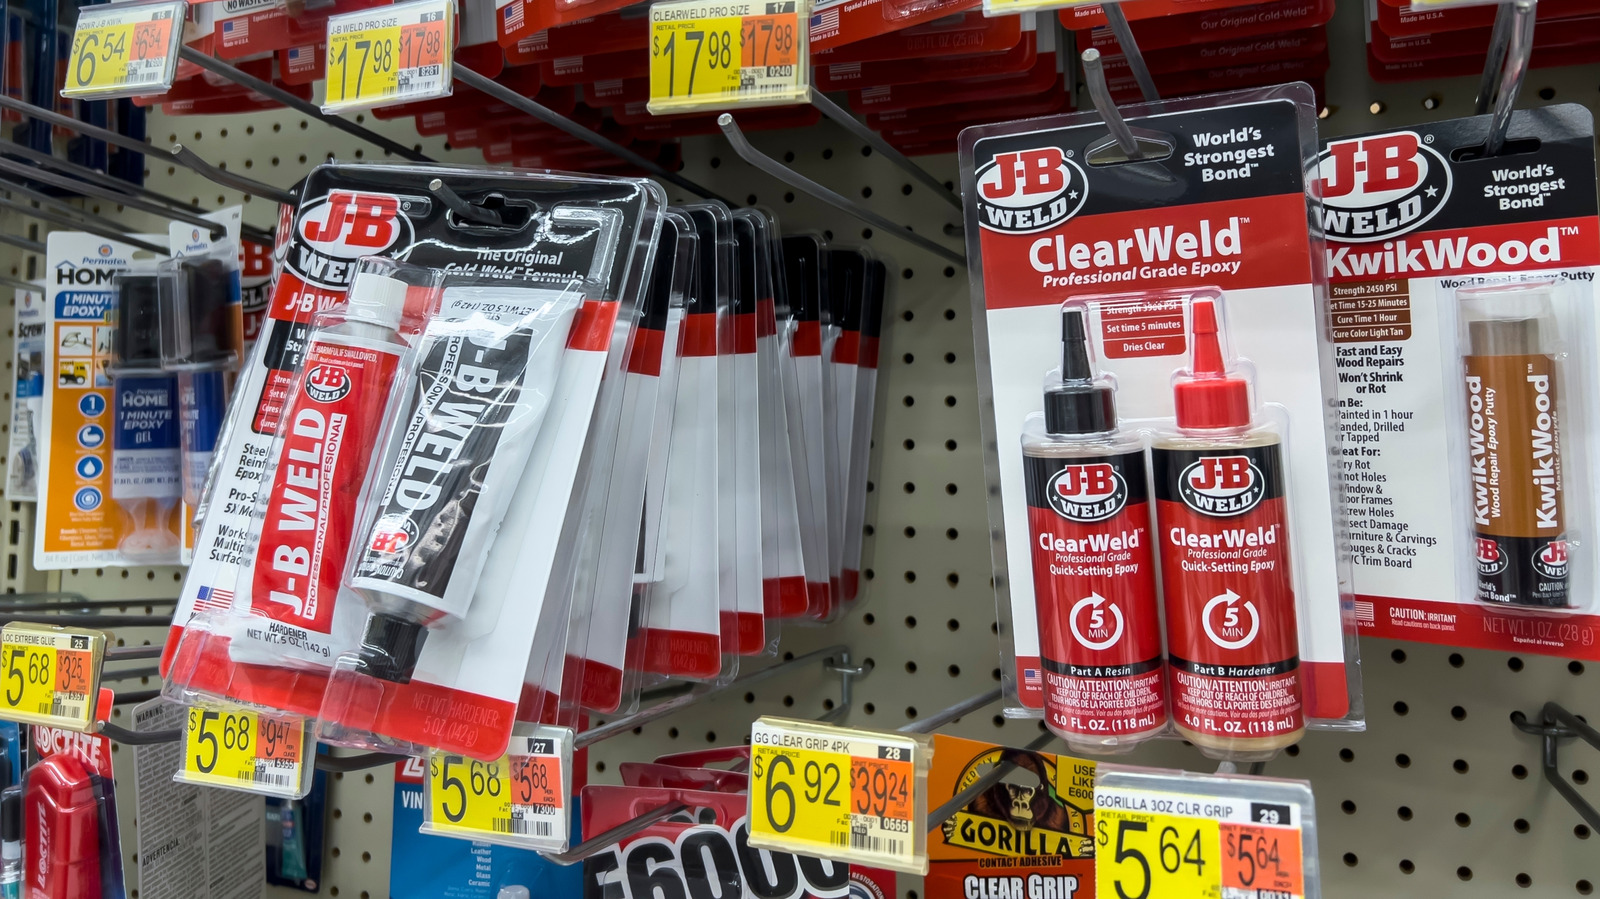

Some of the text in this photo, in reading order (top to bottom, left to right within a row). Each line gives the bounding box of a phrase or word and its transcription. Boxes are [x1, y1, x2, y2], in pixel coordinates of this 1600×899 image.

[653, 5, 750, 22] CLEARWELD PRO SIZE
[773, 3, 785, 13] 17
[426, 12, 437, 22] 16
[331, 18, 398, 35] J-B WELD PRO SIZE
[421, 66, 439, 77] 8281
[769, 66, 792, 77] 0240
[1193, 127, 1262, 148] World's
[1184, 144, 1275, 168] Strongest
[1492, 164, 1555, 182] World's
[1483, 178, 1565, 198] Strongest
[985, 197, 1067, 229] WELD
[82, 256, 127, 266] Permatex
[476, 247, 564, 267] The Original
[1042, 260, 1241, 288] Professional Grade Epoxy
[1333, 283, 1397, 296] Strength 2450 PSI
[285, 291, 316, 312] J-B
[1338, 298, 1408, 310] Time 15-25 Minutes
[63, 306, 105, 317] EPOXY
[1123, 340, 1165, 352] Dries Clear
[1336, 345, 1403, 358] Fast and Easy
[1335, 356, 1405, 370] Wood Repairs
[1338, 371, 1404, 383] Won't Shrink
[308, 386, 341, 402] WELD
[89, 396, 96, 410] 1
[122, 395, 169, 407] HOME
[124, 420, 164, 430] EPOXY
[1374, 422, 1405, 432] Drilled
[1346, 432, 1380, 444] Tapped
[1486, 387, 1501, 518] Wood Repair Epoxy Putty
[1355, 460, 1371, 470] Rot
[1361, 472, 1387, 482] Holes
[1193, 491, 1253, 512] WELD
[1361, 494, 1393, 505] Frames
[269, 408, 326, 616] J-B WELD
[1060, 497, 1116, 518] WELD
[1368, 507, 1395, 518] Holes
[305, 416, 344, 618] PROFESSIONAL/PROFESIONAL
[1370, 519, 1409, 532] Damage
[1395, 531, 1437, 548] Carvings
[1187, 547, 1268, 559] Professional Grade
[1386, 544, 1417, 556] Cracks
[1055, 552, 1131, 563] Professional Grade
[1361, 555, 1413, 569] Trim Board
[1049, 563, 1139, 578] Quick-Setting Epoxy
[1181, 559, 1275, 574] Quick-Setting Epoxy
[1089, 609, 1104, 629] 5
[1223, 607, 1239, 627] 5
[1389, 606, 1457, 624] CAUTION: IRRITANT
[269, 621, 308, 641] HARDENER
[1088, 628, 1109, 639] MIN
[1222, 627, 1244, 637] MIN
[2, 633, 56, 646] LOC EXTREME GLUE
[74, 639, 84, 649] 25
[247, 628, 331, 658] NET WT. 5 OZ. (142 g)
[1070, 665, 1131, 676] Part A Resin
[1193, 664, 1276, 676] Part B Hardener
[412, 692, 430, 711] NET
[449, 701, 500, 727] HARDENER
[1184, 714, 1294, 735] 4.0 FL. OZ. (118 mL)
[534, 743, 546, 754] 27
[754, 732, 850, 754] GG CLEAR GRIP 4PK
[758, 748, 801, 759] RETAIL PRICE
[885, 747, 901, 761] 28
[535, 803, 556, 815] 7300
[1096, 794, 1148, 811] GORILLA
[1176, 802, 1200, 816] CLR
[1204, 804, 1233, 819] GRIP
[1101, 811, 1155, 823] RETAIL PRICE
[1259, 809, 1280, 825] 29
[883, 818, 908, 832] 0666
[961, 818, 1073, 859] GORILLA
[37, 802, 47, 889] LOCTITE
[475, 863, 491, 872] Metal
[979, 856, 1062, 868] CONTACT ADHESIVE
[475, 871, 491, 879] Glass
[468, 879, 491, 887] Ceramic
[964, 874, 1078, 899] CLEAR GRIP
